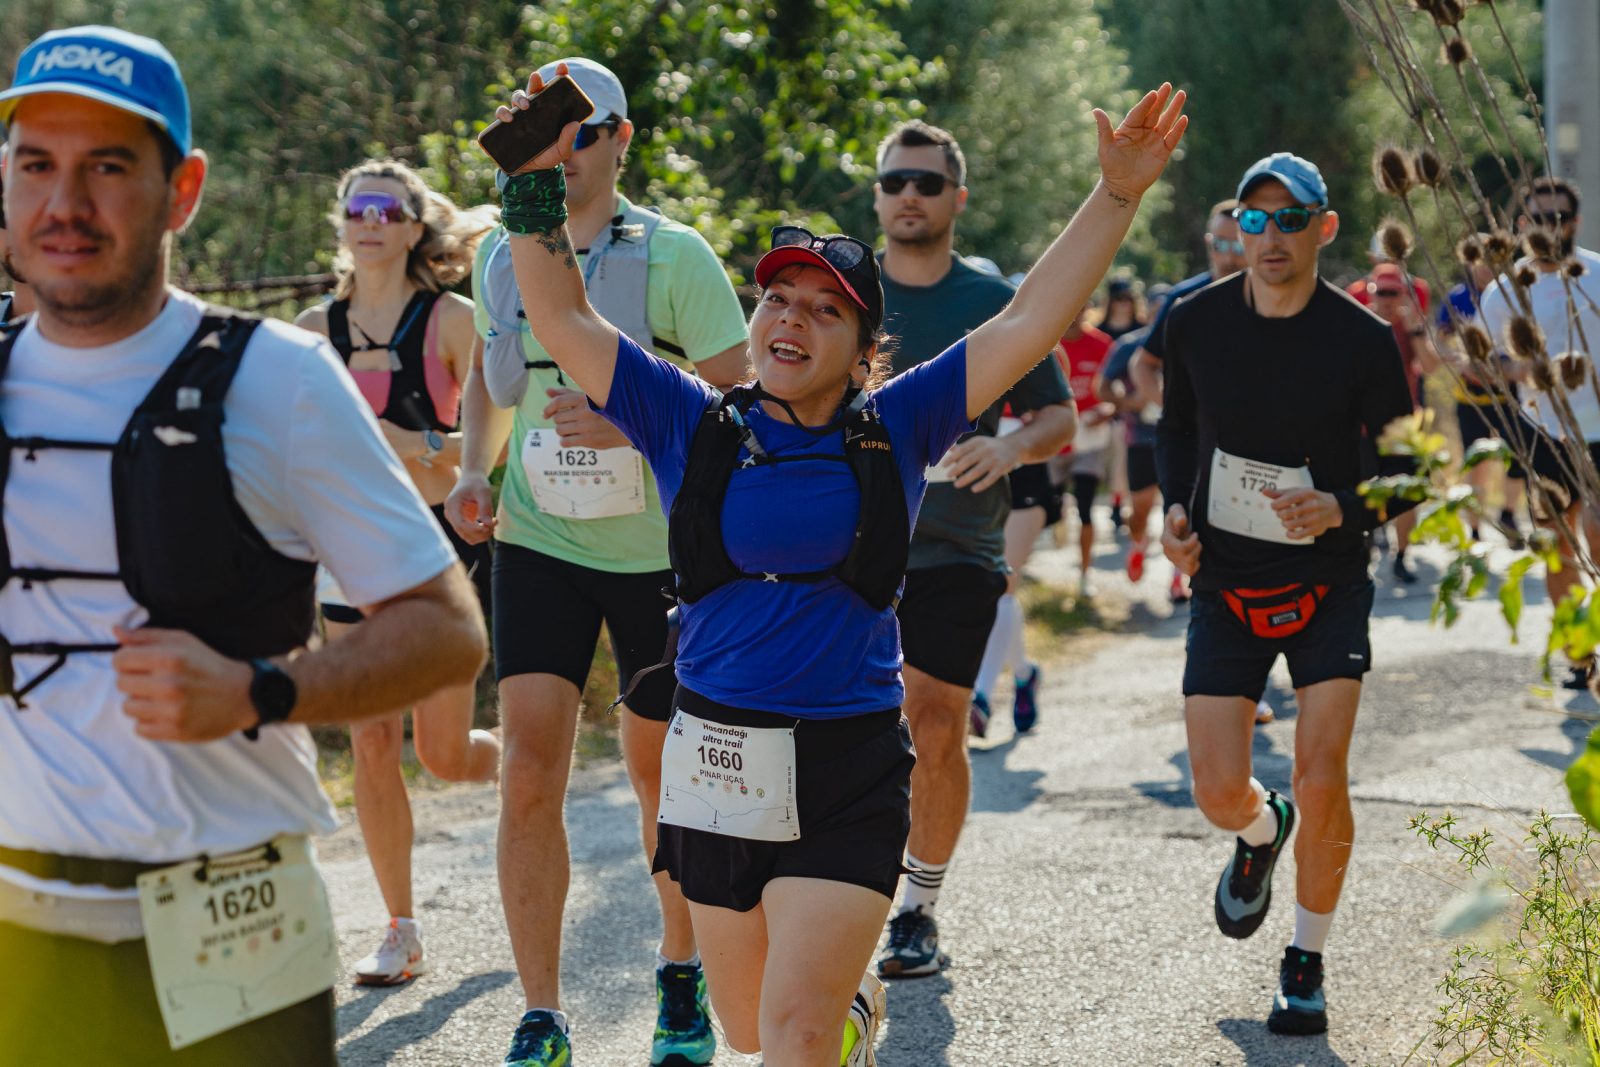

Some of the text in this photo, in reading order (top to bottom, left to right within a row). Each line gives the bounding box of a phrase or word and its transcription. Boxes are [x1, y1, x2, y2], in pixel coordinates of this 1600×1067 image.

[30, 45, 134, 87] HOKA
[555, 450, 598, 466] 1623
[702, 734, 743, 749] ultra trail
[697, 745, 743, 772] 1660
[699, 769, 722, 780] PINAR
[204, 879, 276, 925] 1620
